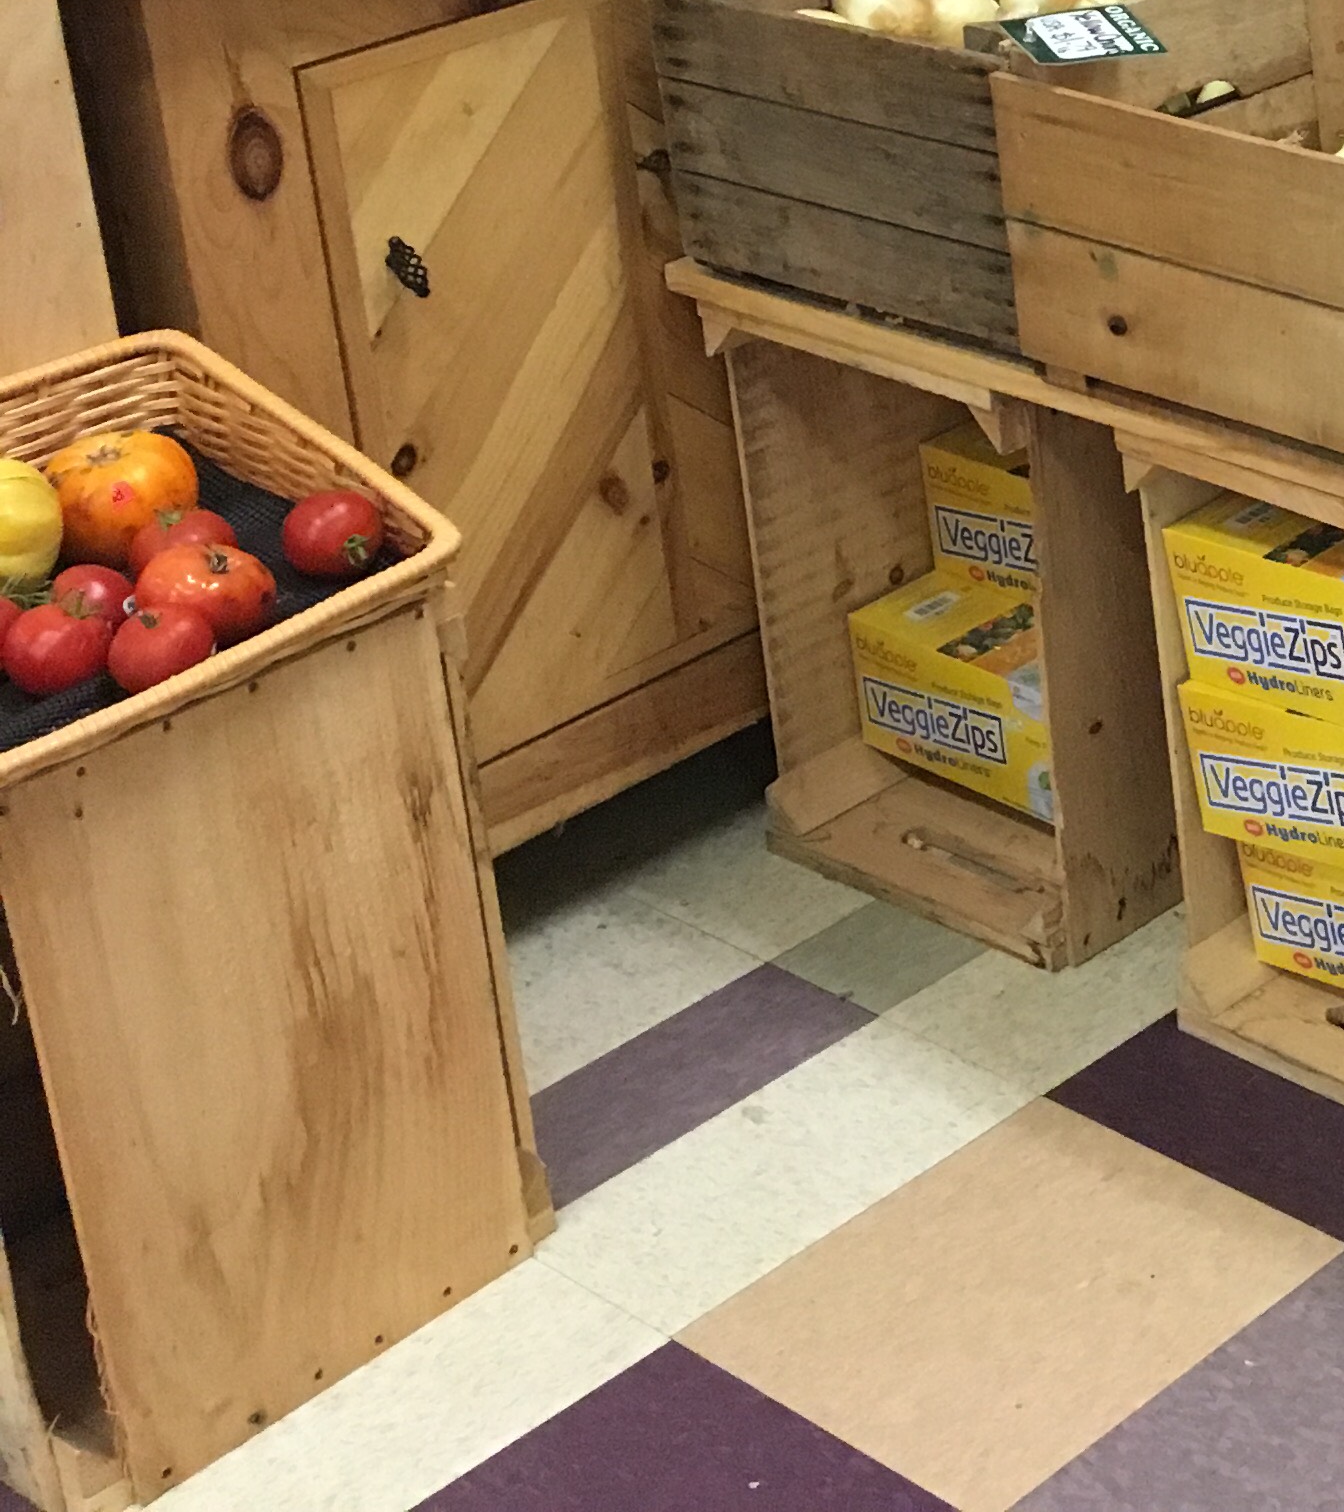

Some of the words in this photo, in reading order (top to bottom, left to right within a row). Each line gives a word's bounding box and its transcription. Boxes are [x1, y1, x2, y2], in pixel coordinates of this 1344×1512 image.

[1104, 5, 1160, 52] ORGANIC
[1193, 608, 1343, 674] VeggieZips
[1246, 669, 1335, 702] HydroLiners
[870, 685, 999, 755] VeggieZips
